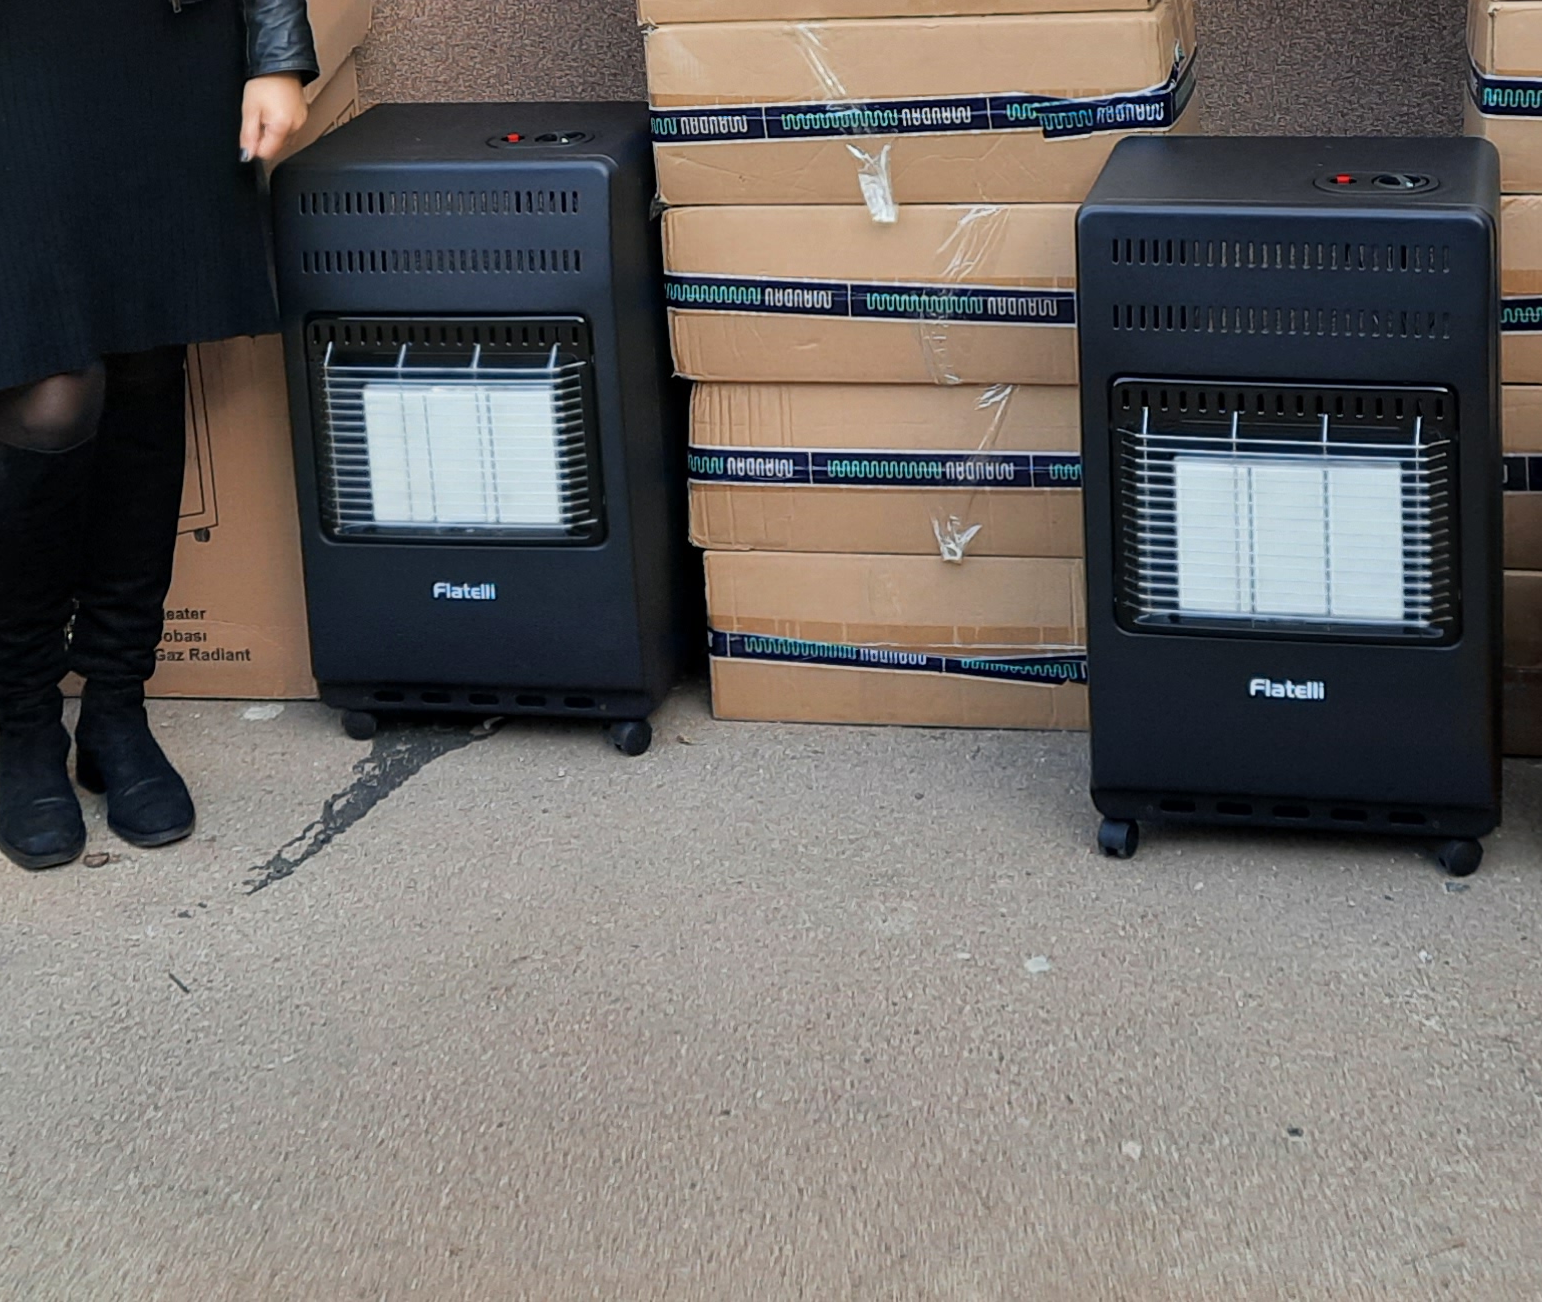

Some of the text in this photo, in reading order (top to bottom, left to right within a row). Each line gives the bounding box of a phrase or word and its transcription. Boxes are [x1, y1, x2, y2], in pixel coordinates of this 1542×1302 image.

[163, 608, 206, 620] eater
[163, 630, 207, 642] obası
[155, 647, 251, 661] Gaz Radiant
[1250, 679, 1325, 700] Flatelli
